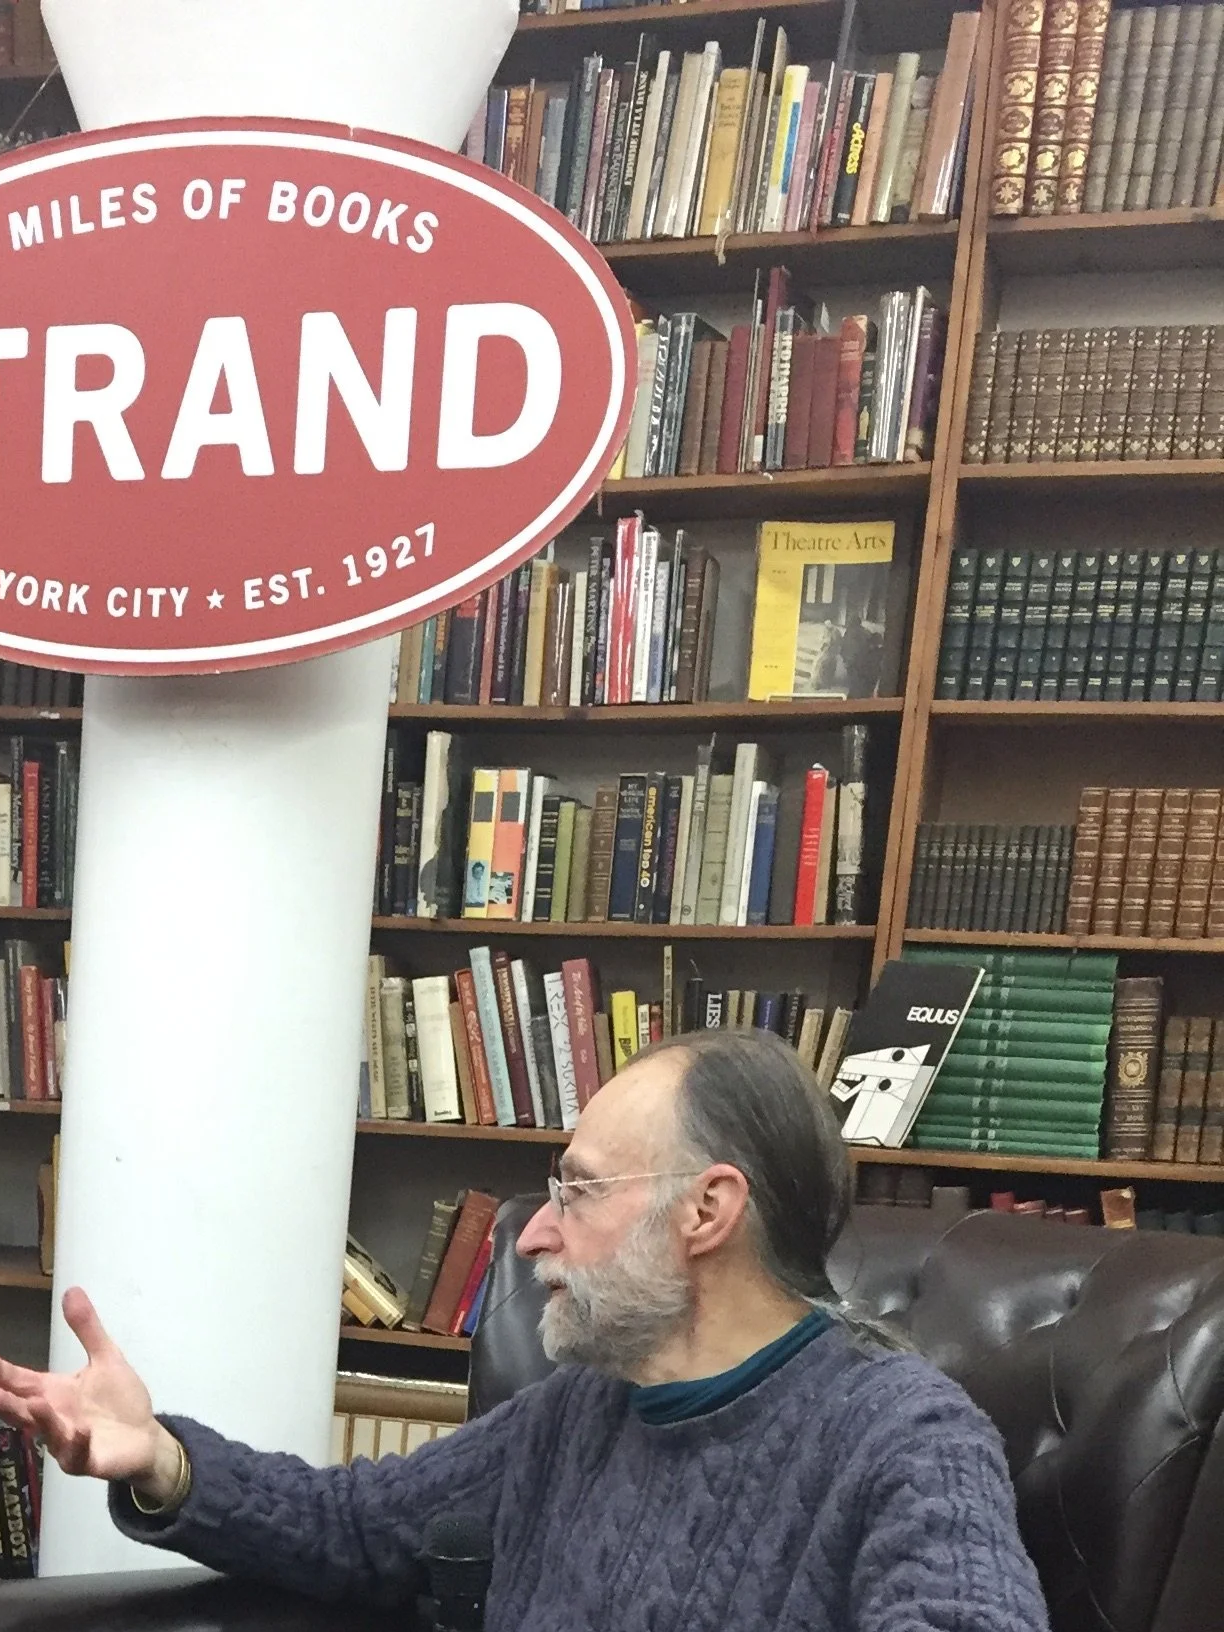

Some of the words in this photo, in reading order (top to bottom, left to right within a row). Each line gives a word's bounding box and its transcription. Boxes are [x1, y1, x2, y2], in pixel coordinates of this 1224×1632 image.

[845, 122, 865, 175] Actress
[8, 181, 160, 253] MILES
[182, 178, 248, 221] OF
[267, 181, 442, 256] BOOKS
[766, 531, 841, 551] Theatre
[847, 531, 886, 551] Arts
[107, 584, 190, 619] CITY
[243, 565, 327, 611] EST.
[344, 521, 437, 587] 1927
[643, 787, 657, 846] american
[639, 869, 651, 889] 40
[641, 848, 654, 868] top
[706, 993, 723, 1028] LIES
[907, 1006, 960, 1025] EQUUS
[1, 1465, 27, 1558] PLAYBOY
